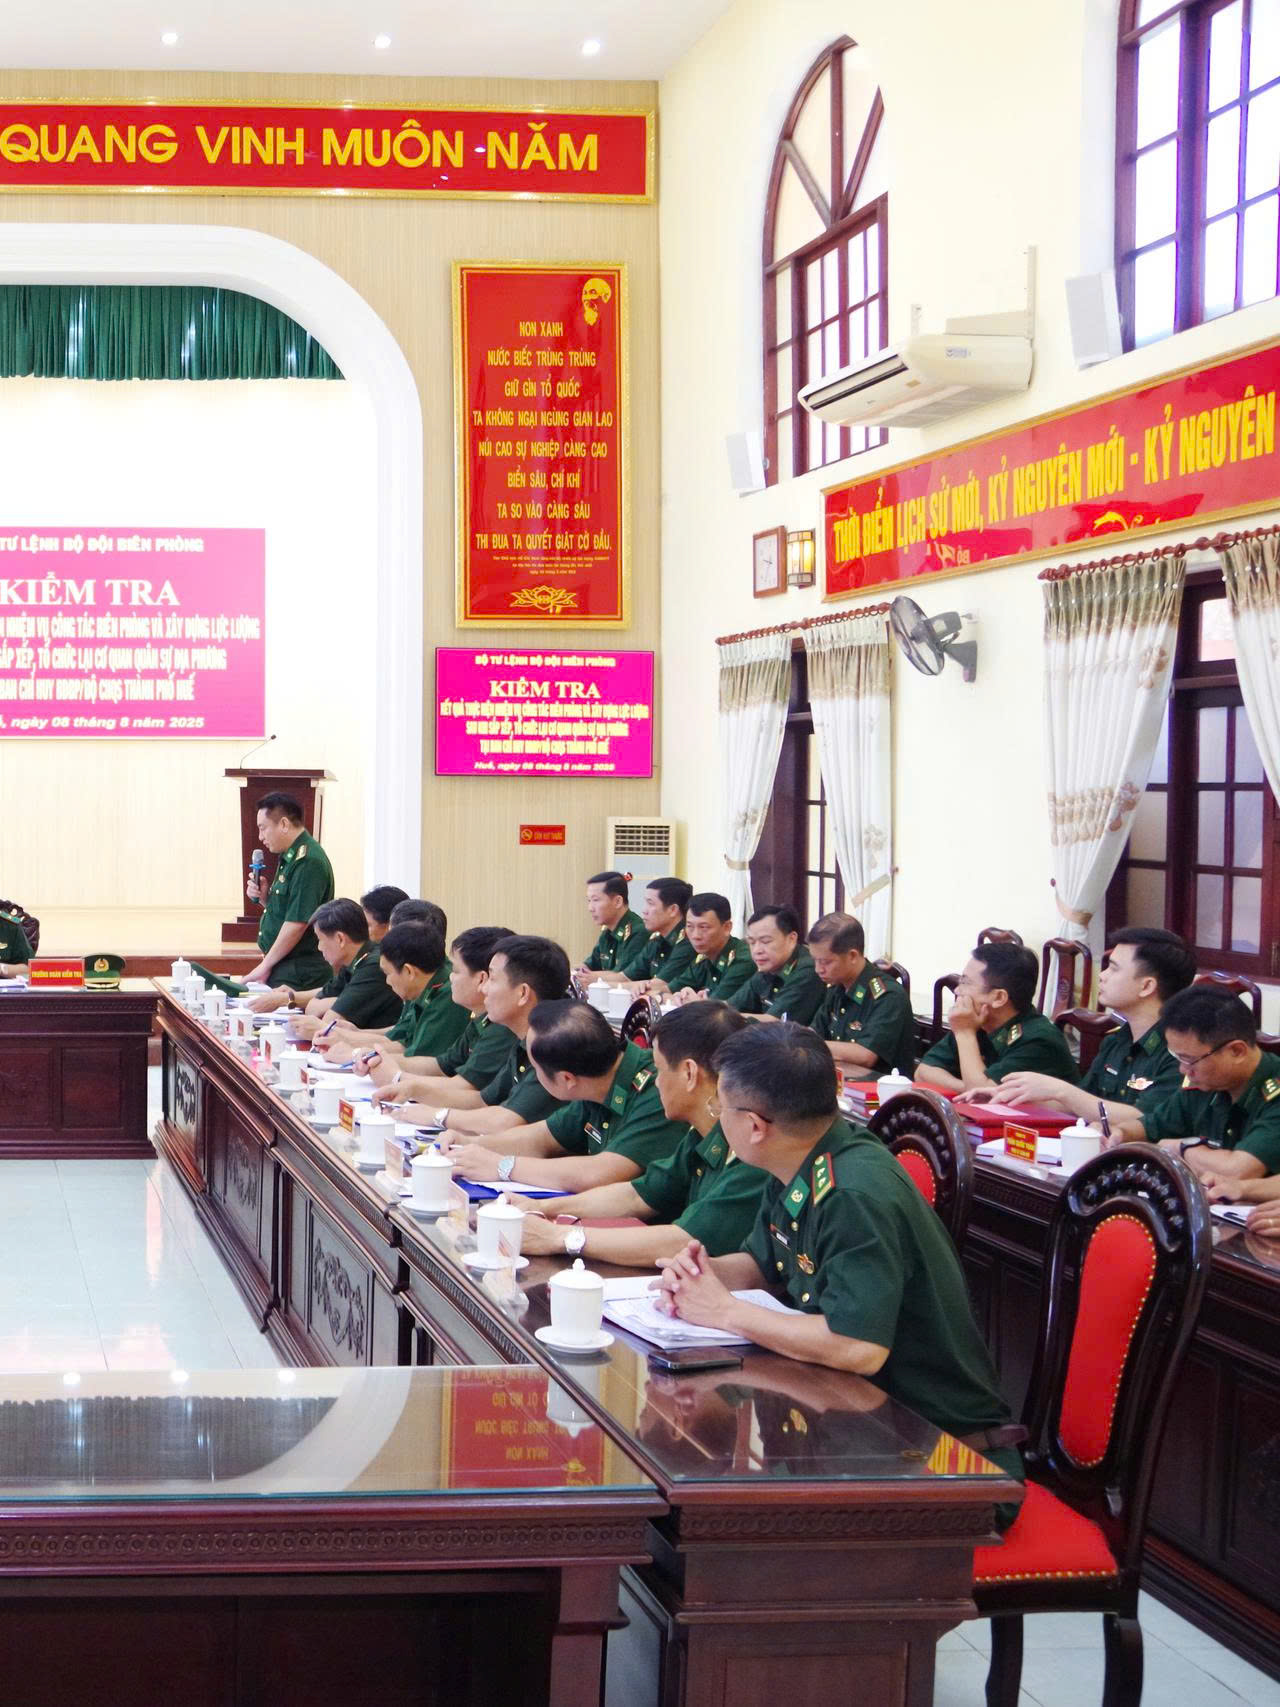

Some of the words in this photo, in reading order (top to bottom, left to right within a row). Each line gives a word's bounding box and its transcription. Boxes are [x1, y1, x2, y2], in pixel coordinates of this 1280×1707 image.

[0, 123, 177, 164] QUANG
[196, 126, 305, 165] VINH
[322, 119, 463, 168] MUÔN
[487, 122, 598, 171] NĂM
[519, 321, 536, 336] NON
[540, 321, 563, 336] XANH
[488, 347, 510, 366] NƯỚC
[514, 344, 532, 366] BIẾC
[536, 347, 563, 366] TRÙNG
[569, 348, 596, 367] TRÙNG
[504, 378, 519, 396] GIỮ
[523, 378, 536, 396] GÌN
[541, 373, 552, 396] TỔ
[556, 375, 580, 398] QUỐC
[473, 410, 482, 425] TA
[486, 407, 514, 426] KHÔNG
[518, 411, 537, 429] NGẠI
[541, 407, 569, 426] NGÙNG
[573, 411, 592, 427] GIAN
[596, 411, 613, 427] LAO
[479, 437, 492, 456] NÚI
[496, 441, 513, 456] CAO
[516, 440, 527, 461] SỰ
[531, 438, 560, 461] NGHIỆP
[564, 438, 586, 457] CÀNG
[591, 442, 607, 457] CAO
[508, 465, 526, 488] BIỂN
[551, 469, 564, 487] CHÍ
[567, 469, 580, 488] KHÍ
[833, 506, 860, 563] THỜI
[862, 486, 894, 556] ĐIỂM
[896, 496, 926, 554] LỊCH
[929, 475, 950, 539] SỬ
[952, 470, 984, 533] MỚI,
[988, 455, 1009, 525] KỶ
[1013, 442, 1082, 518] NGUYÊN
[1087, 424, 1125, 500] MỚI
[1144, 403, 1174, 485] KỶ
[1179, 384, 1276, 477] NGUYÊN
[497, 503, 507, 518] TA
[511, 503, 522, 518] SO
[526, 500, 542, 518] VÀO
[547, 500, 570, 518] CÀNG
[574, 500, 590, 518] SÂU
[476, 534, 488, 549] THI
[492, 534, 508, 549] ĐUA
[512, 534, 522, 549] TA
[526, 528, 552, 550] QUYẾT
[556, 531, 573, 552] GIẬT
[578, 530, 589, 549] CỜ
[105, 579, 180, 606] TRA
[489, 676, 551, 698] KIỂM
[555, 681, 601, 699] TRA
[11, 717, 48, 730] ngày
[51, 717, 70, 728] 08
[73, 716, 116, 730] tháng
[120, 717, 129, 728] 8
[133, 717, 166, 728] năm
[169, 717, 205, 728] 2025
